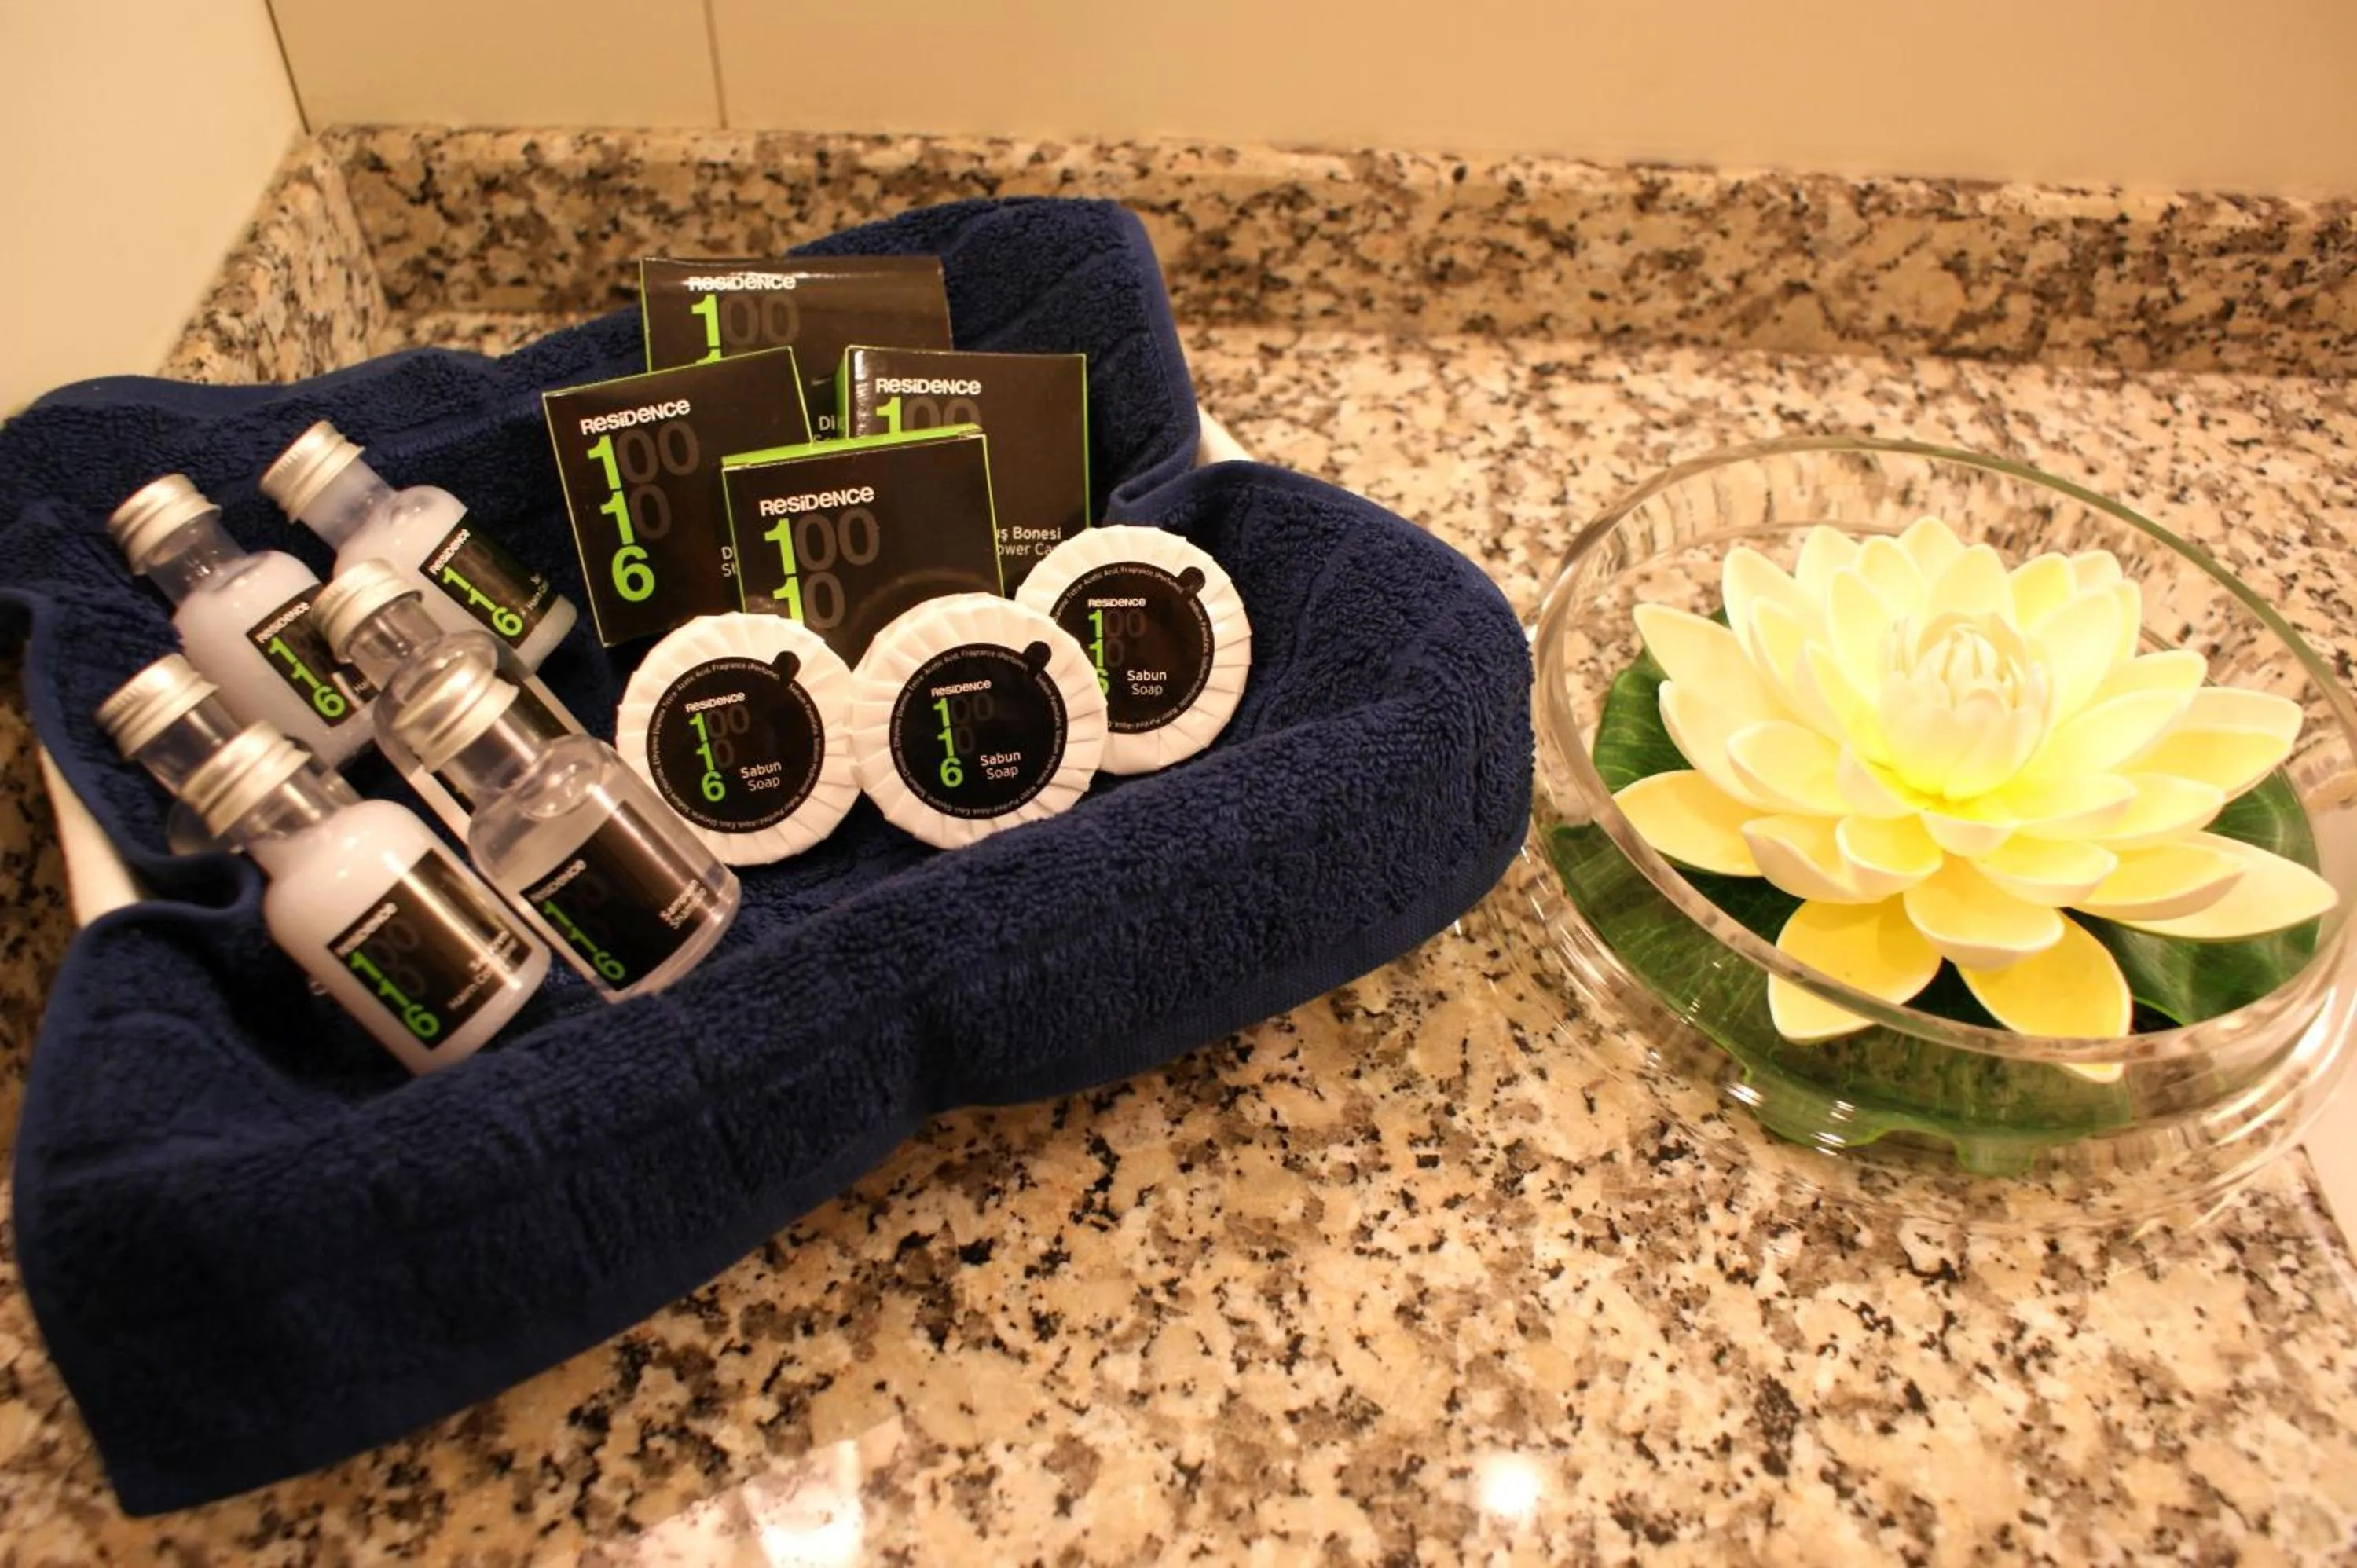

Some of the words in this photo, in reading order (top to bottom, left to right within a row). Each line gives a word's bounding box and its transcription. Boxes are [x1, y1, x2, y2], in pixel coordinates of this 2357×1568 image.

[1013, 526, 1061, 540] Bonesi
[997, 544, 1031, 556] ower
[1035, 542, 1054, 555] Ca
[1127, 669, 1167, 681] Sabun
[1131, 683, 1164, 696] Soap
[980, 751, 1021, 767] Sabun
[740, 761, 782, 779] Sabun
[986, 765, 1019, 781] Soap
[748, 776, 780, 792] Soap
